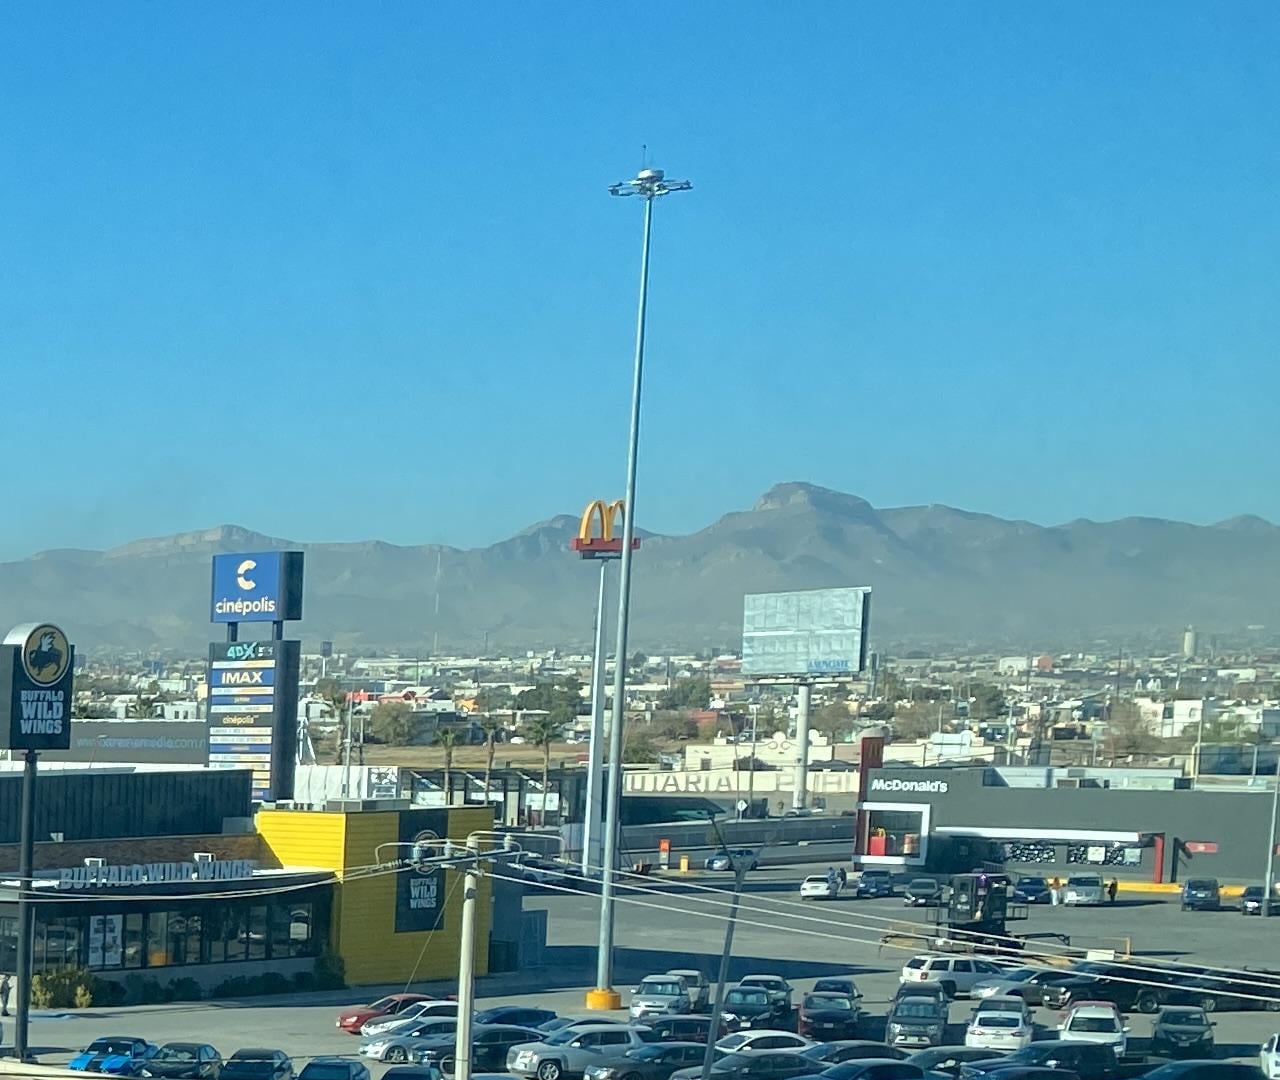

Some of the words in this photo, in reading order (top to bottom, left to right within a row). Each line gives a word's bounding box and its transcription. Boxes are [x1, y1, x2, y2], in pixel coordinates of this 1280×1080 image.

[215, 595, 276, 615] cinépolis
[227, 642, 258, 659] 4DX
[221, 672, 264, 684] IMAX
[20, 690, 64, 702] BUFFALO
[21, 702, 64, 719] WILD
[20, 720, 63, 734] WINGS
[871, 779, 948, 793] McDonald's
[59, 864, 144, 889] BUFFALO
[145, 861, 192, 883] WILD
[197, 859, 255, 881] WINGS
[410, 886, 437, 898] WILD
[410, 898, 437, 909] WINGS
